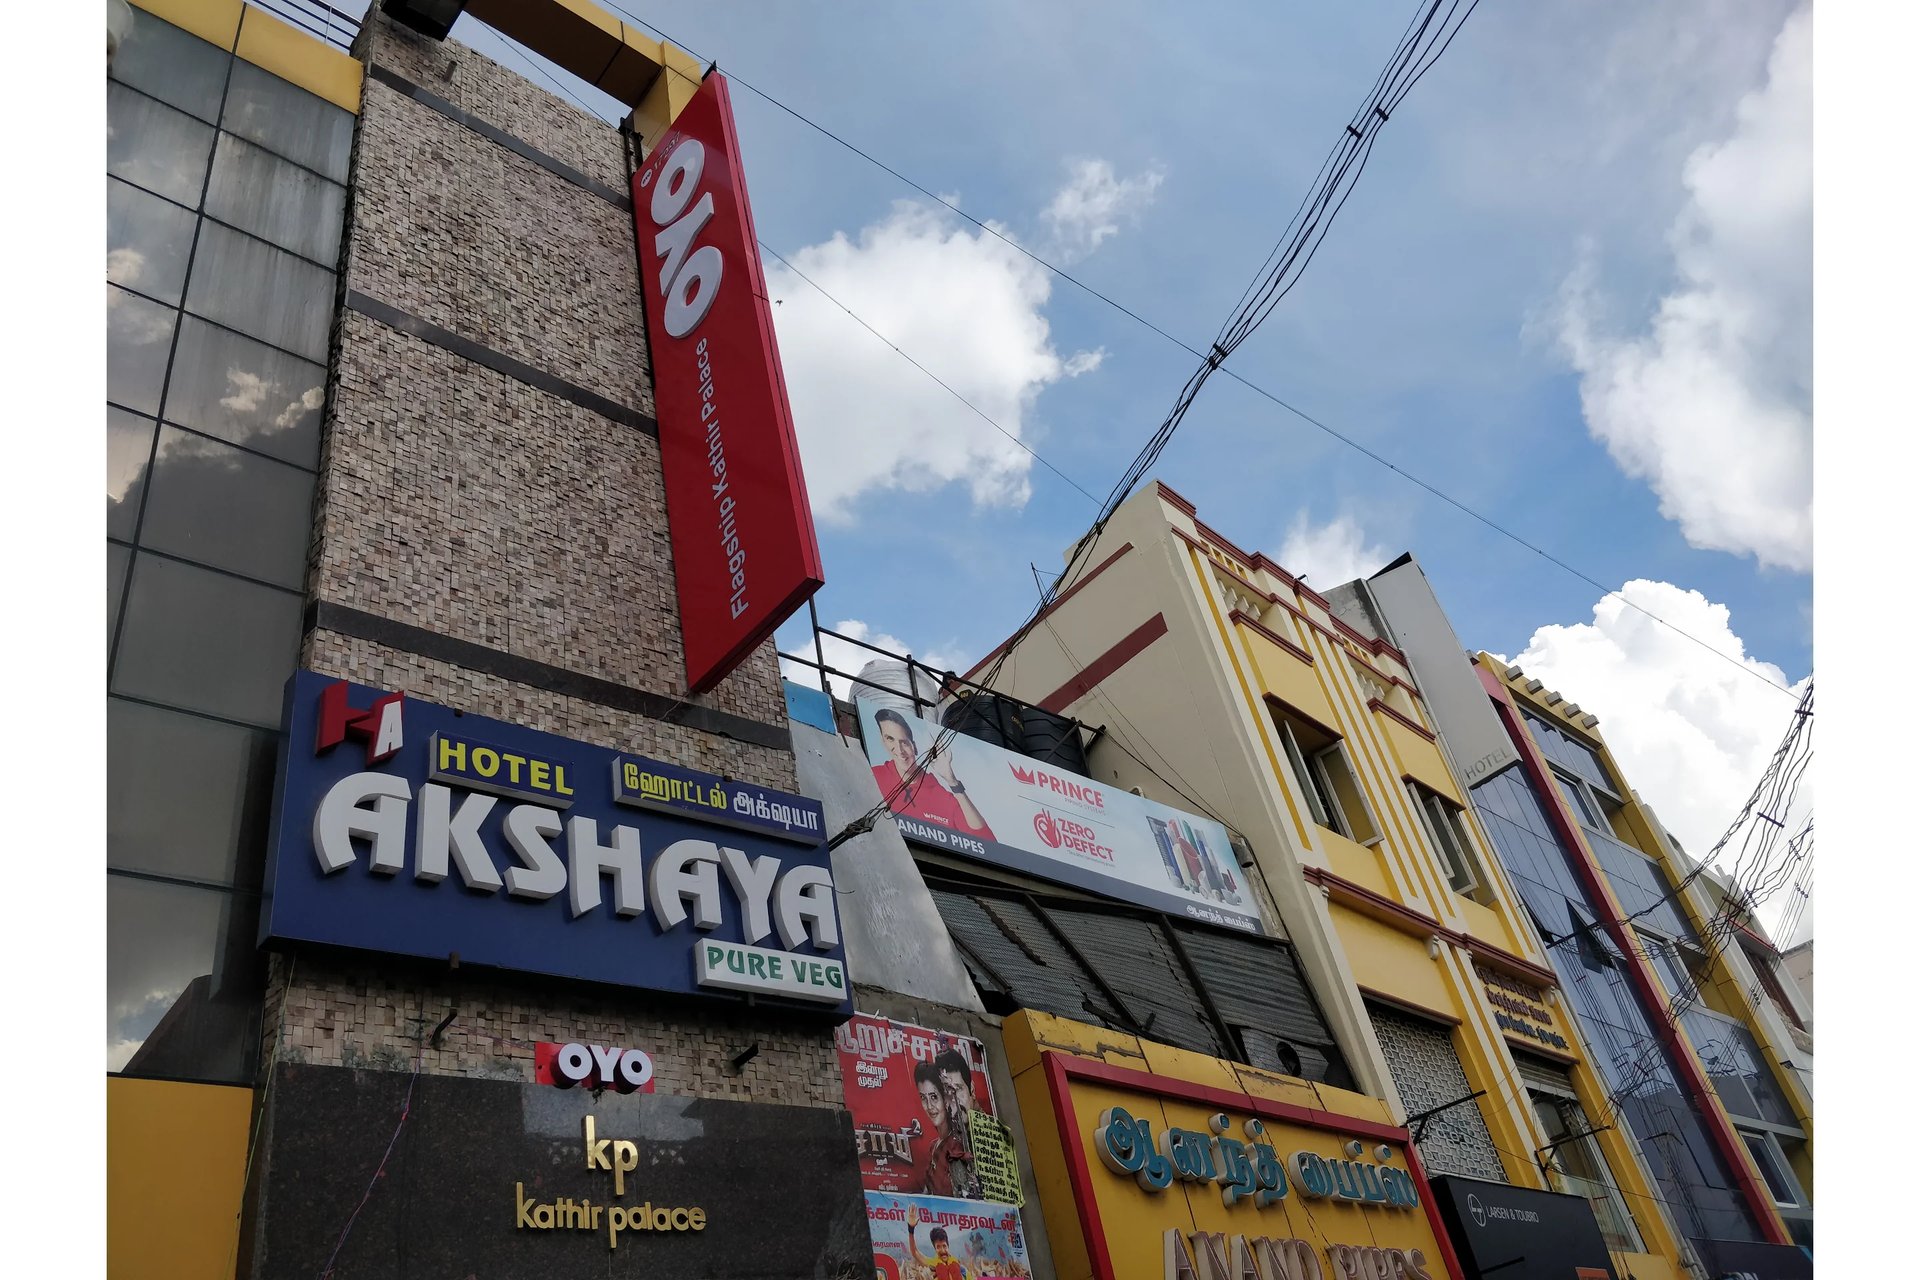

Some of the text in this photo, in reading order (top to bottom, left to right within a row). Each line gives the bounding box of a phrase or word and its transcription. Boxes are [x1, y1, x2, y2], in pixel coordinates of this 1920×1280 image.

[651, 139, 723, 338] OYO
[695, 336, 750, 621] Flagship Kathir Palace
[438, 738, 575, 796] HOTEL
[624, 762, 728, 811] ஹோட்டல்
[1464, 747, 1512, 780] HOTEL
[1037, 770, 1104, 808] PRINCE
[898, 818, 986, 855] ANAND PIPES
[929, 813, 950, 824] PRINCE
[1058, 818, 1096, 841] ZERO
[313, 770, 840, 953] AKSHAYA
[1063, 834, 1114, 862] DEFECT
[707, 945, 843, 990] PURE VEG
[556, 1042, 653, 1090] OYO
[581, 1114, 639, 1196] kp
[1094, 1106, 1289, 1211] ஆனந்த்
[516, 1182, 707, 1249] kathir palace
[1485, 1206, 1539, 1223] LARSEN & TOUBRO
